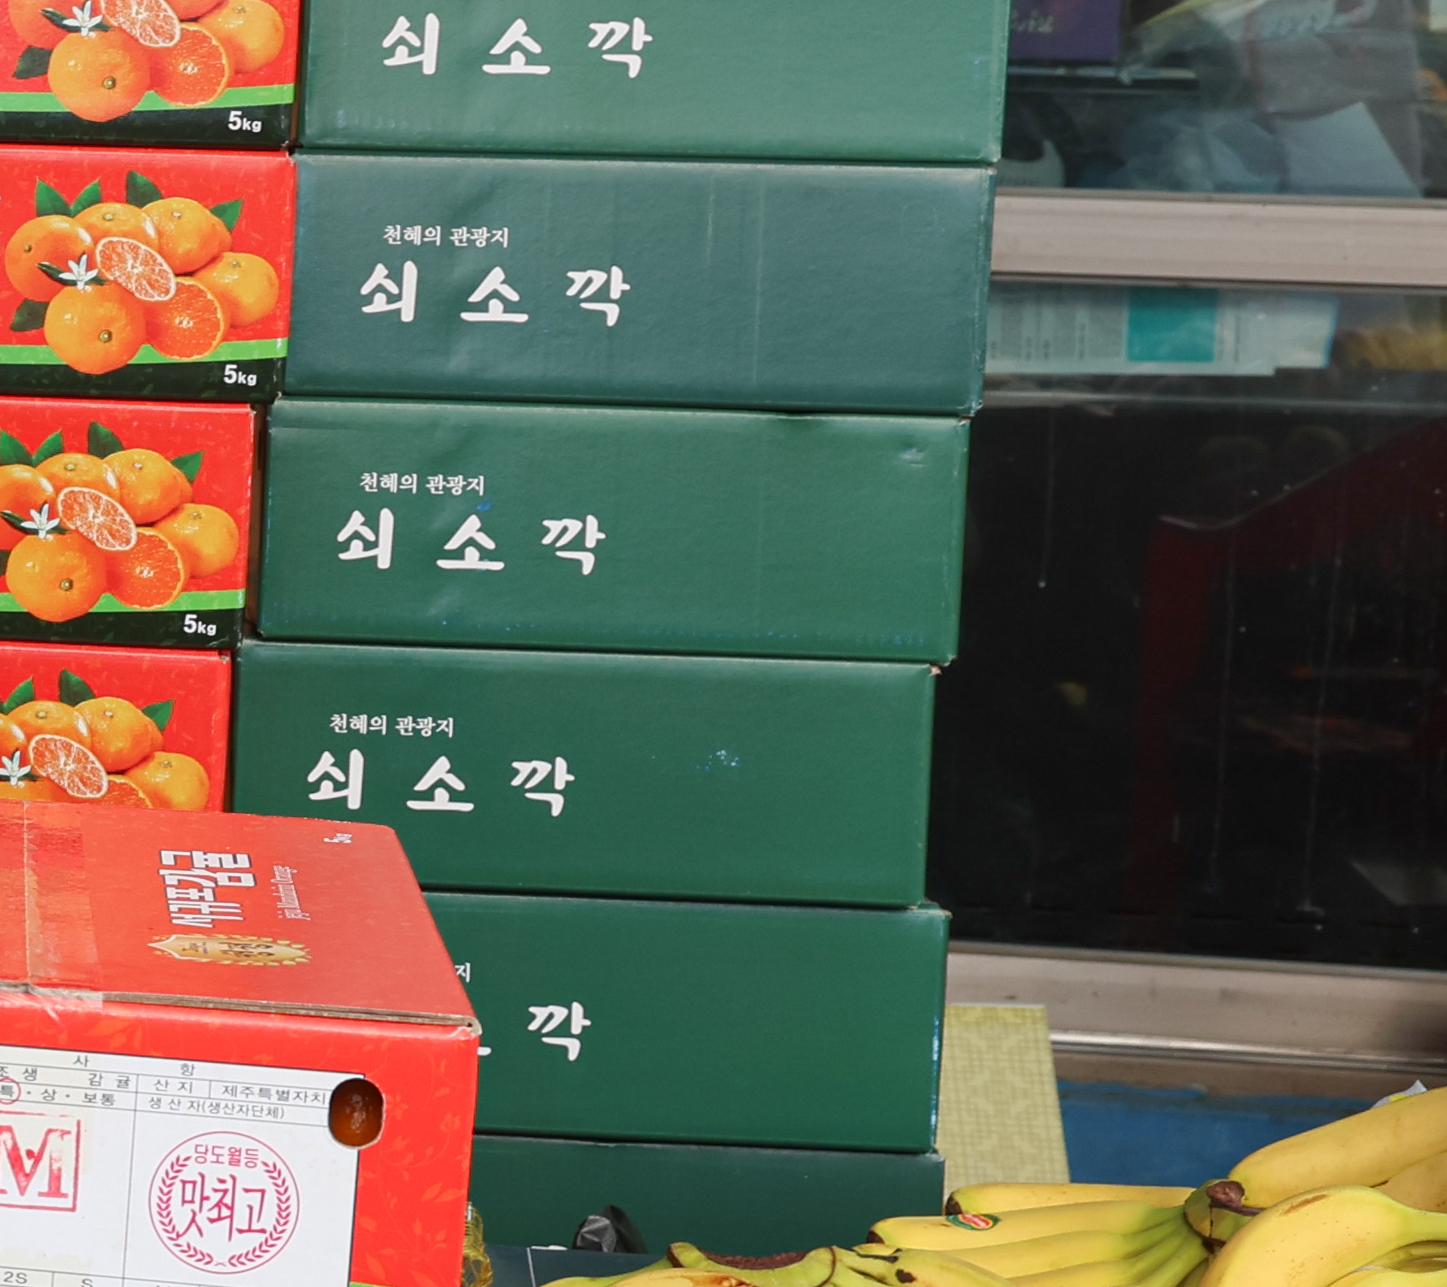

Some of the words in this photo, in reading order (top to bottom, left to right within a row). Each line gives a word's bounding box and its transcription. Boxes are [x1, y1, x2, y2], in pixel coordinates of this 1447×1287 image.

[227, 110, 262, 134] 5kg
[383, 224, 442, 247] 천혜의
[449, 226, 510, 249] 관광지
[224, 364, 258, 387] 5kg
[360, 472, 418, 495] 천혜의
[426, 473, 485, 497] 관광지
[183, 614, 217, 636] 5kg
[329, 713, 388, 736] 천혜의
[394, 715, 454, 738] 관광지
[193, 1144, 260, 1169] 당도월등
[178, 1172, 269, 1243] 맛최고
